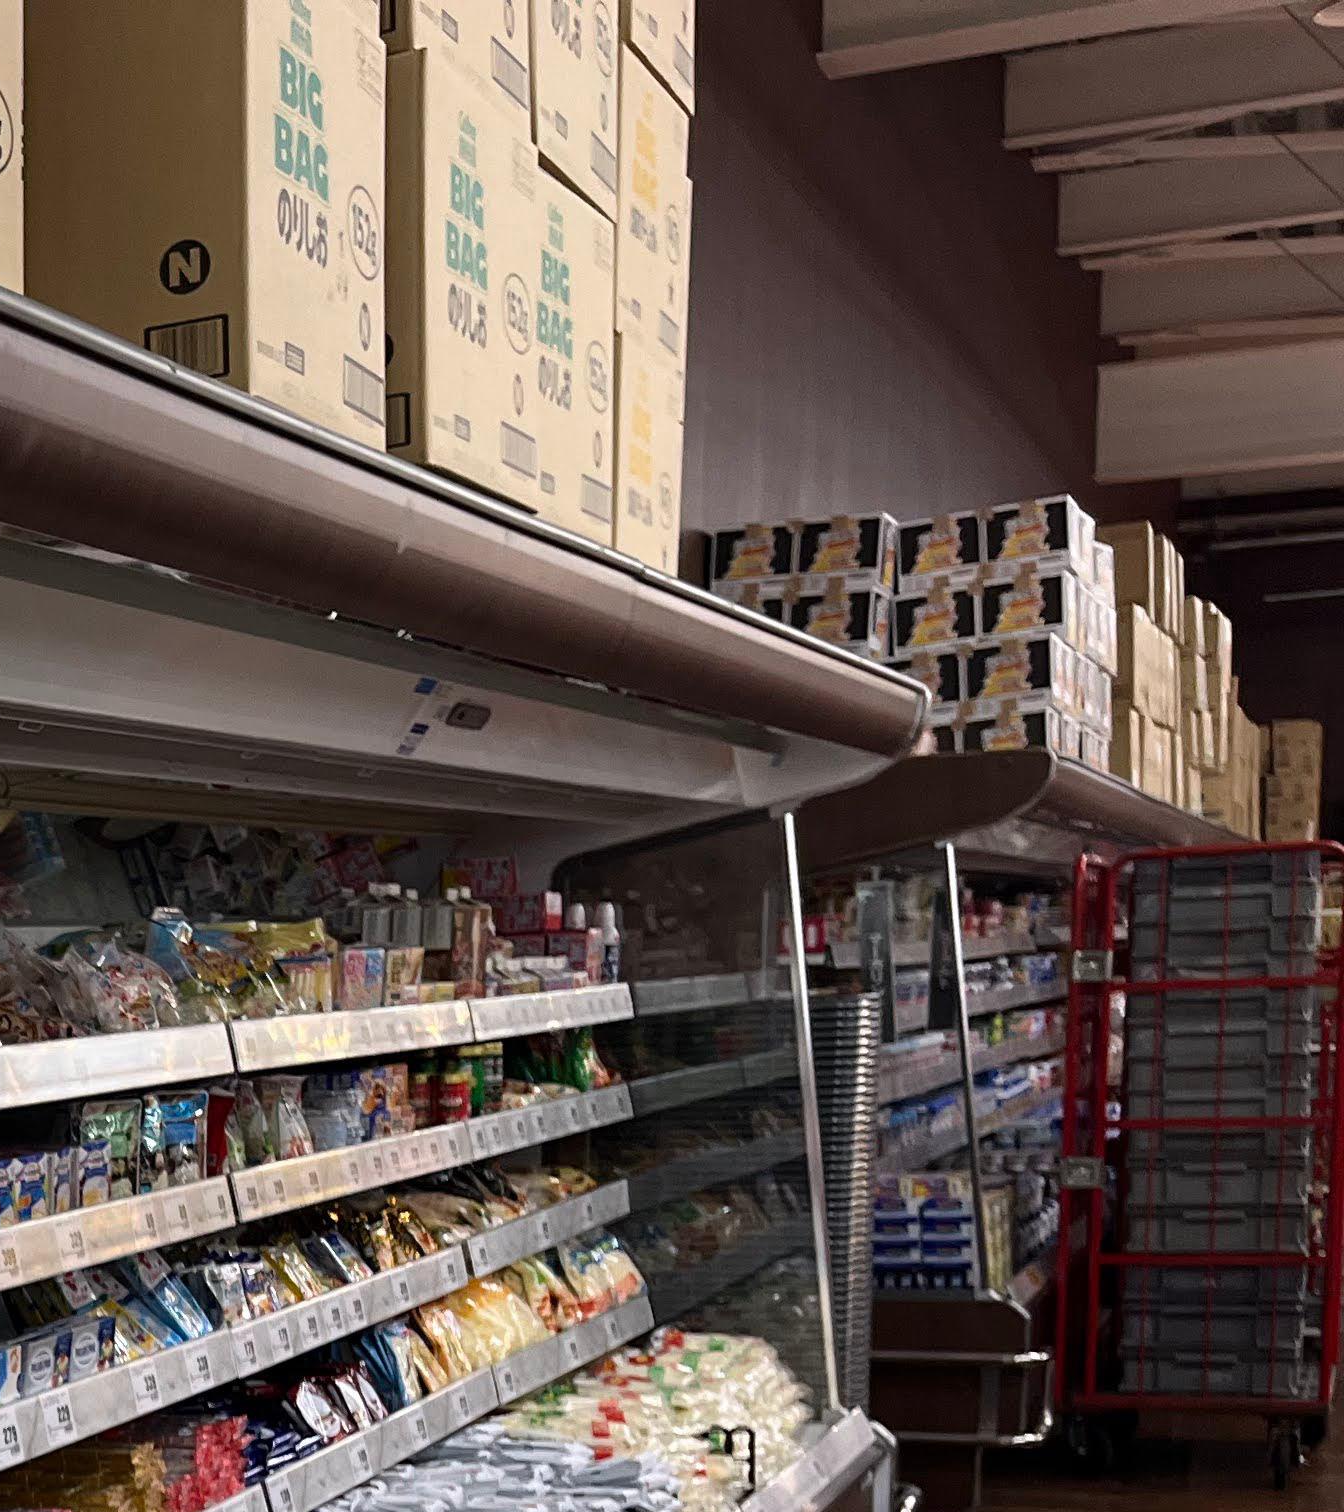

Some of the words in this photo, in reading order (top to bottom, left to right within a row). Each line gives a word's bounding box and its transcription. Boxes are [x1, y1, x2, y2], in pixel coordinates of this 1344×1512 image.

[279, 45, 325, 133] BIG
[274, 112, 330, 202] BAG
[277, 188, 328, 268] のりしお
[449, 162, 485, 230] BIG
[168, 247, 202, 290] N
[444, 219, 488, 291] BAG
